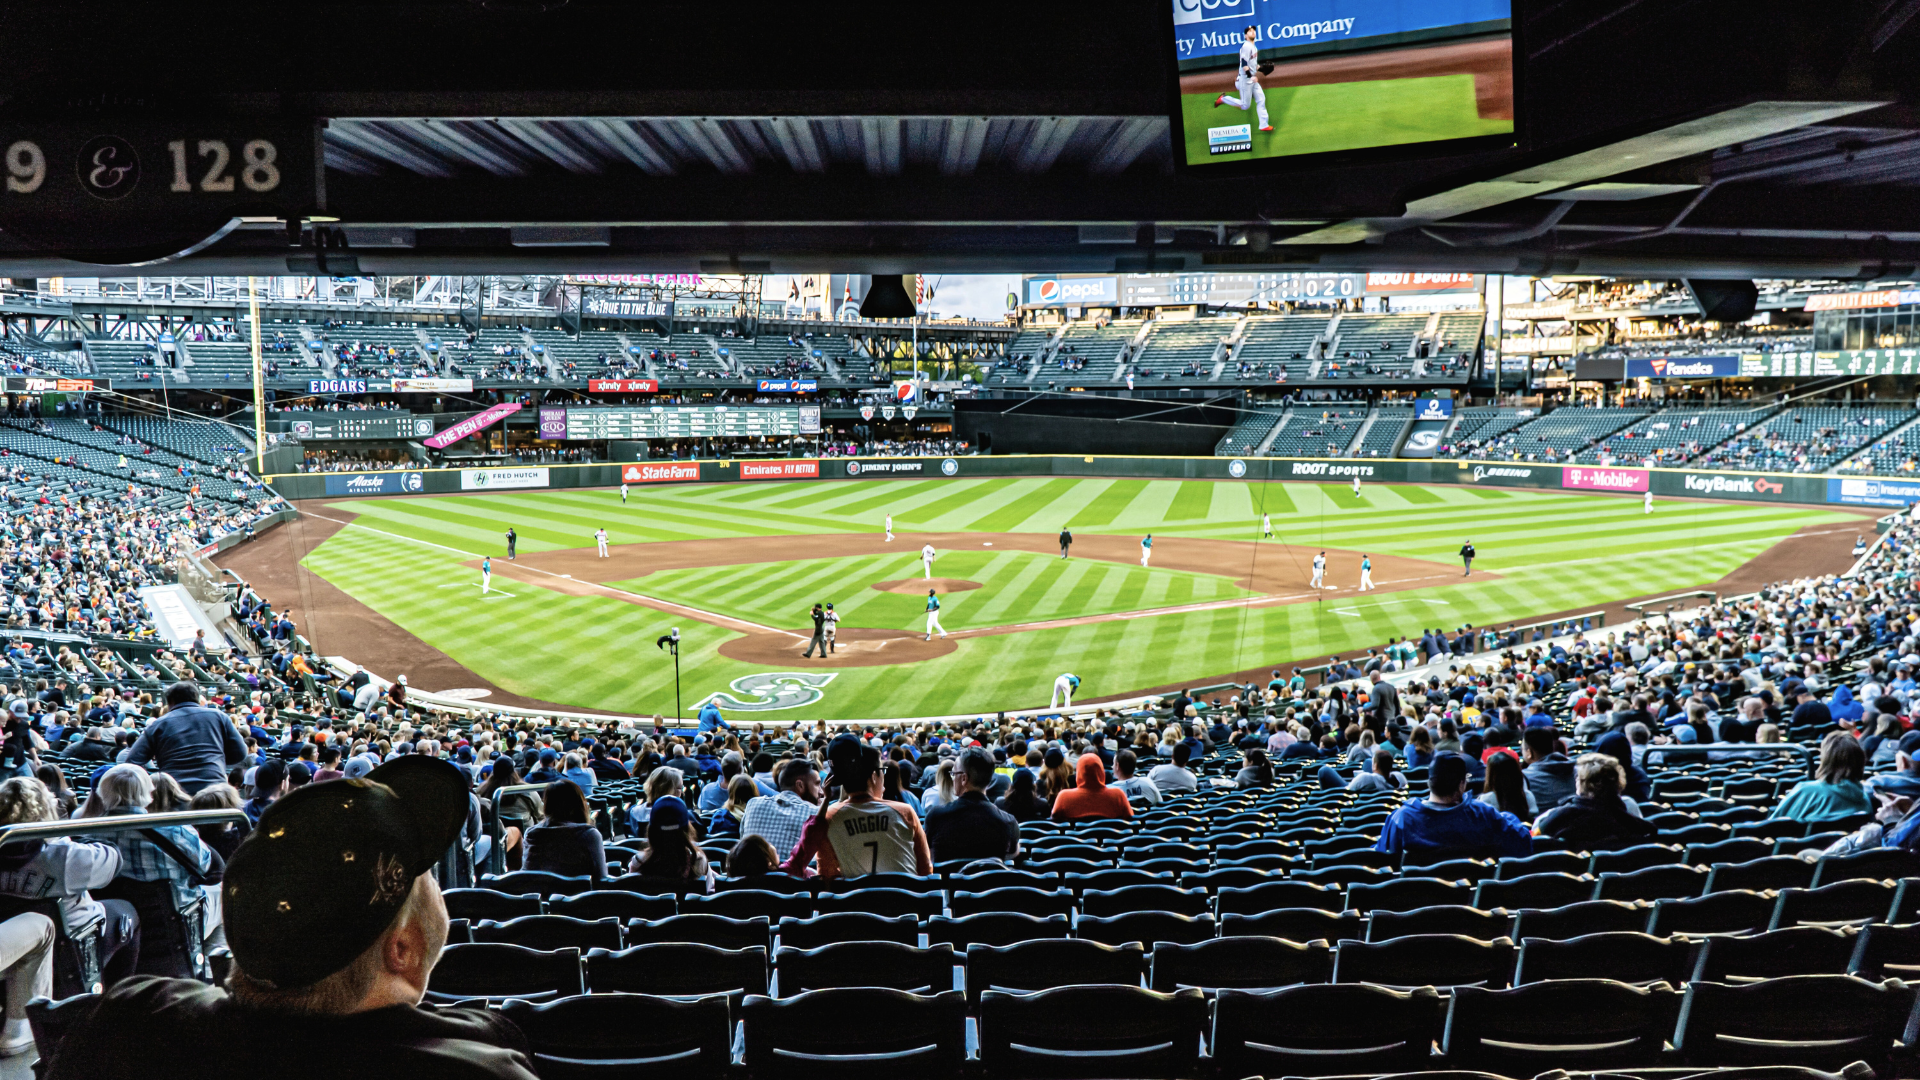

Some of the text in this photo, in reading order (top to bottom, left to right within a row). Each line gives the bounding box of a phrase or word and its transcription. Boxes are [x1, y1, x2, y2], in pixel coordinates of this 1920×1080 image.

[1201, 24, 1263, 49] Mutul
[1267, 17, 1356, 40] Company
[5, 139, 281, 194] 9 & 128
[1061, 281, 1105, 298] pepsi
[1306, 278, 1353, 296] 0 2 0
[599, 299, 667, 316] TRUE TO THE BLUE
[1666, 362, 1713, 375] Fanatics
[25, 378, 45, 391] 710
[57, 378, 94, 391] ESPN
[435, 429, 458, 446] THE
[743, 464, 816, 475] Emirates FLY BETTER
[861, 462, 922, 472] JIMMY JOHN'S
[1292, 462, 1375, 476] ROOT SPORTS
[1487, 468, 1532, 478] BOEING
[347, 475, 383, 486] Alaska
[492, 471, 539, 480] FRED HUTCH
[1684, 475, 1754, 493] KeyBank
[843, 814, 889, 836] BIGGIO
[862, 840, 879, 875] 7
